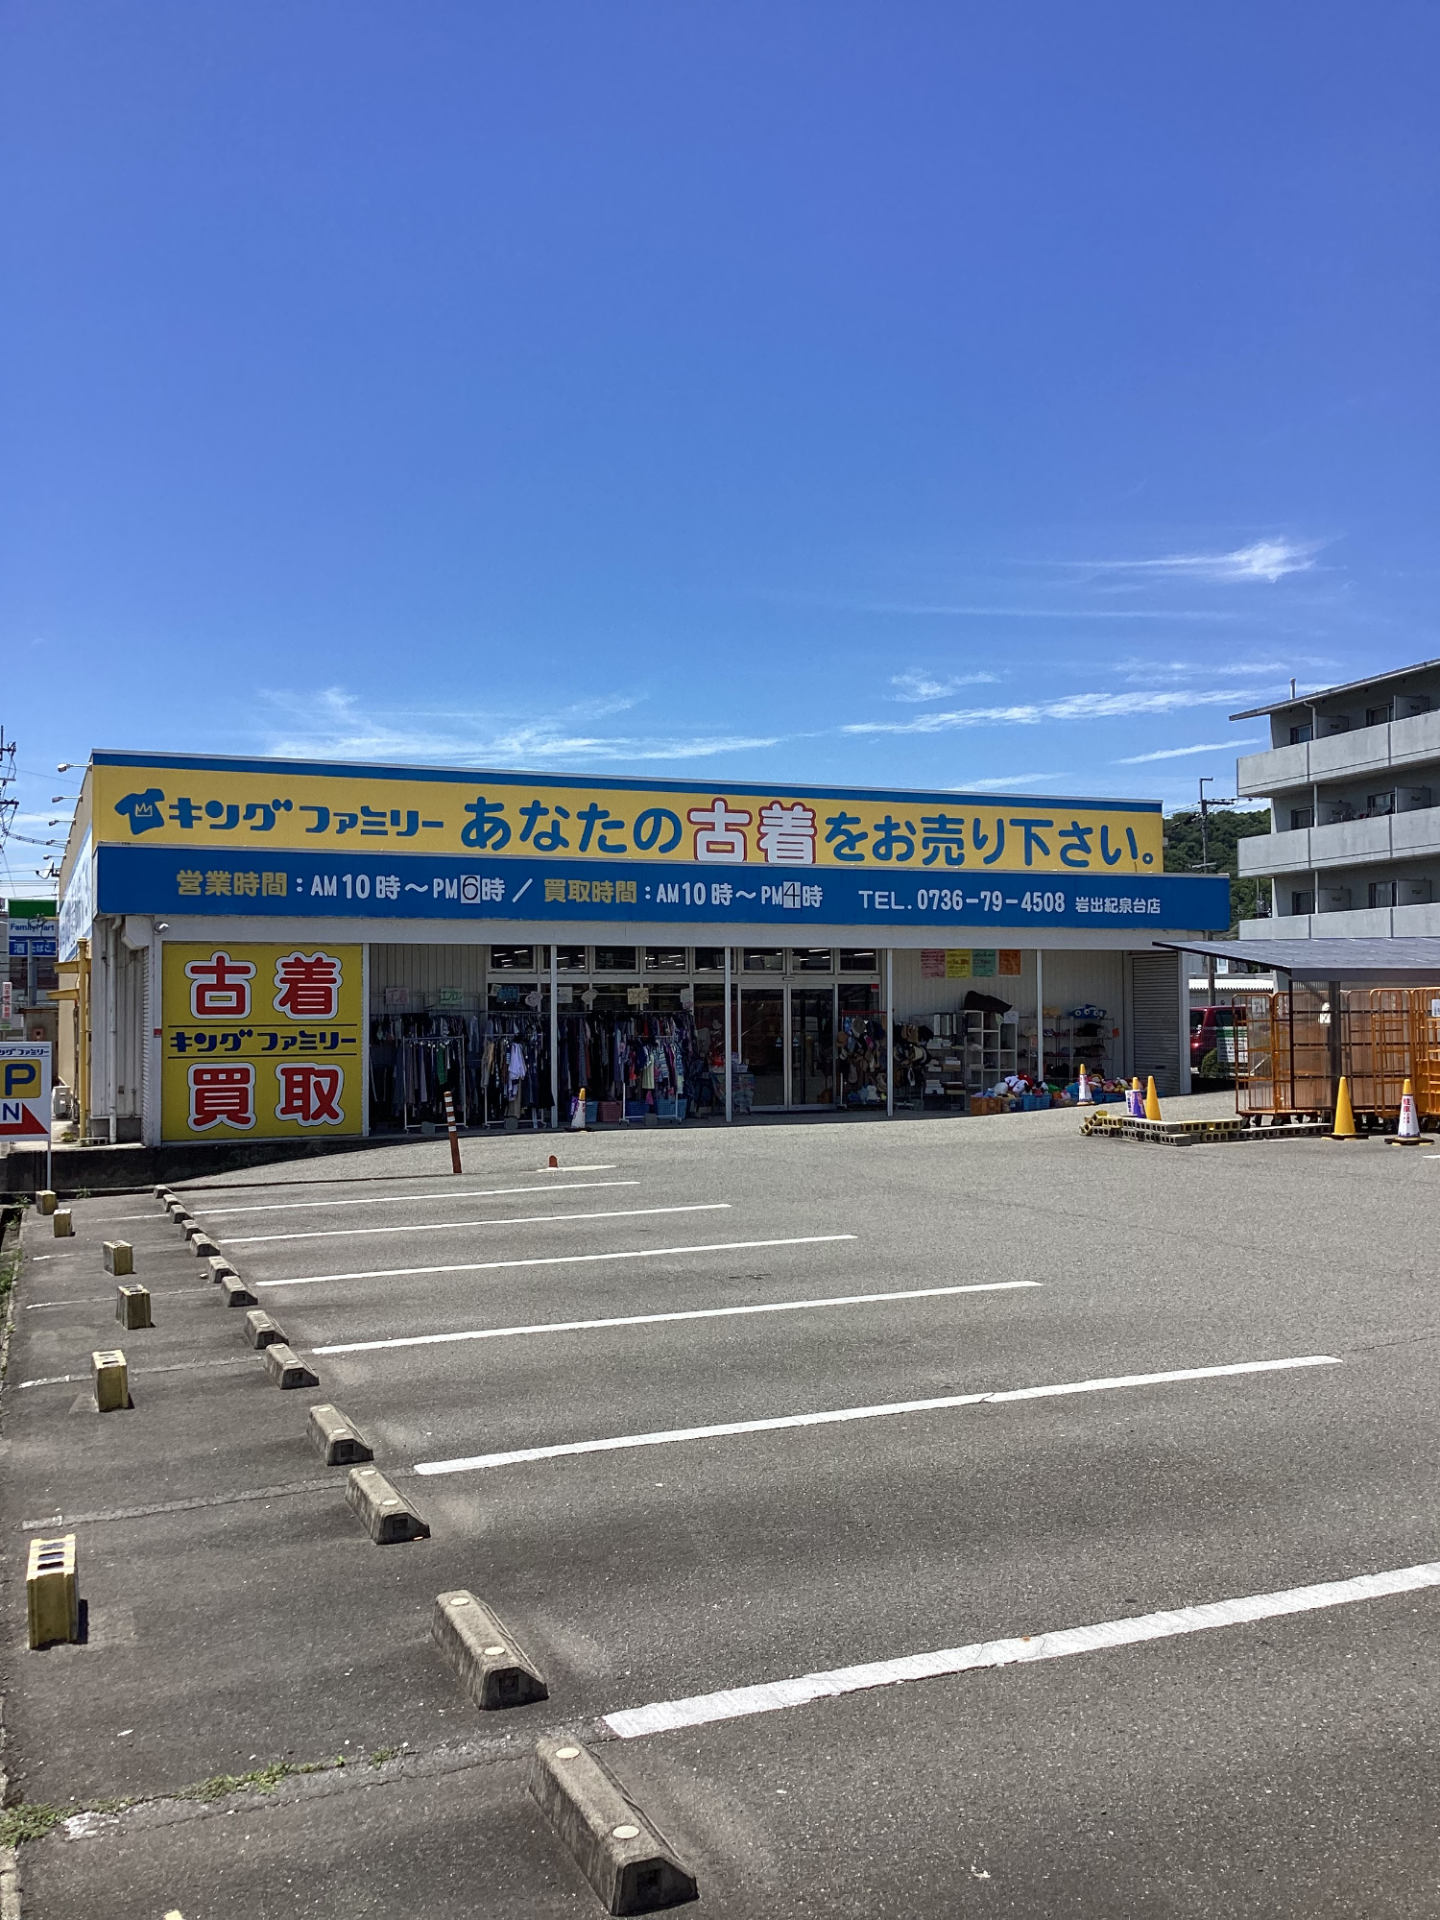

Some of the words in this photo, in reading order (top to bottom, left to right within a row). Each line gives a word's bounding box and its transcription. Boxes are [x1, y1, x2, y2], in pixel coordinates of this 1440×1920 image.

[168, 797, 445, 837] キングファミリー
[1074, 896, 1161, 914] 岩出紀泉台店
[185, 951, 343, 1020] 古着
[170, 1028, 357, 1053] キングファミリー
[187, 1062, 345, 1132] 買取
